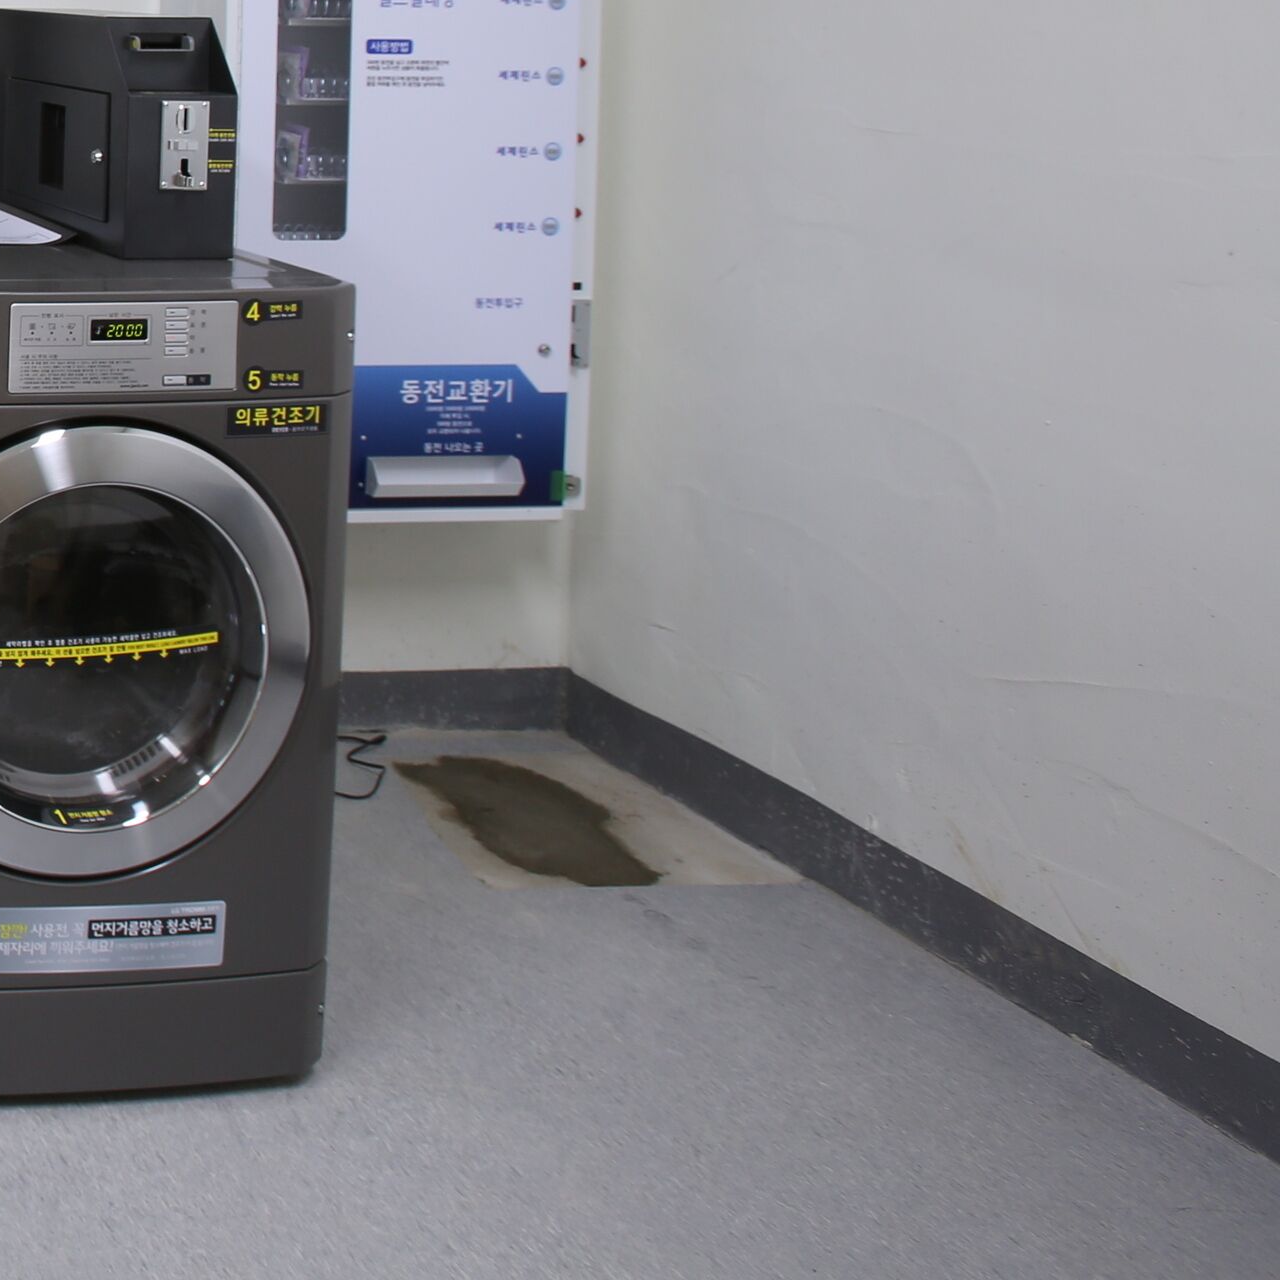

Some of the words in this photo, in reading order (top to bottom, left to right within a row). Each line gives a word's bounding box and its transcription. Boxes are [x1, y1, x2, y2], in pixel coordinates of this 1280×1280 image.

[246, 301, 261, 321] 4
[106, 323, 143, 338] 2000
[247, 370, 261, 391] 5
[400, 379, 513, 404] 동전교환기
[235, 405, 321, 426] 의류건조기
[54, 808, 68, 825] 1
[91, 919, 164, 938] 먼지거름망을
[166, 917, 214, 935] 청소하고
[51, 939, 114, 957] 끼워주세요!
